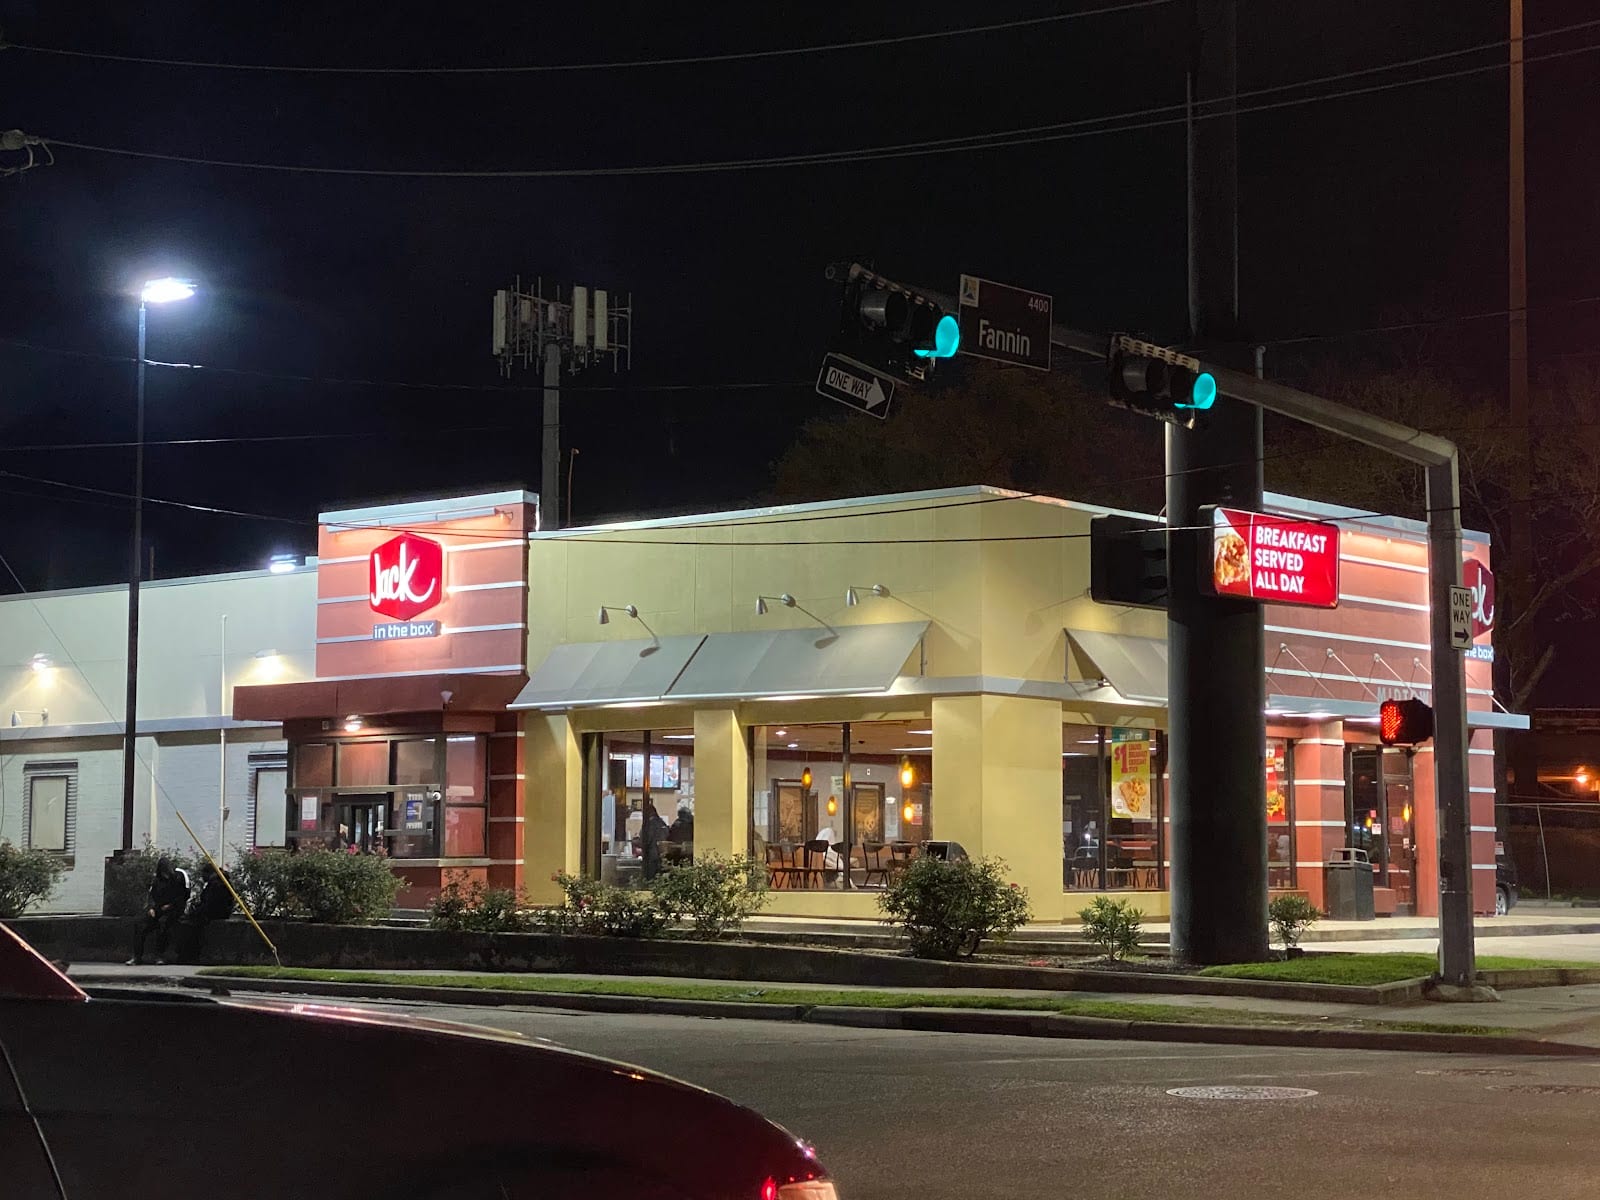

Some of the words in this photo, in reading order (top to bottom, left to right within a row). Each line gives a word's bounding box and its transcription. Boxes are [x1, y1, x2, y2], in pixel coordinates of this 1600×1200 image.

[1028, 297, 1049, 313] 4400
[978, 319, 1031, 357] Fannin
[829, 369, 850, 390] ONE
[851, 378, 872, 398] WAY
[1255, 526, 1327, 554] BREAKFAST
[1255, 548, 1304, 572] SERVED
[370, 543, 435, 607] Jack
[1255, 570, 1279, 591] ALL
[1280, 573, 1305, 594] DAY
[1453, 591, 1470, 608] ONE
[1453, 610, 1470, 625] WAY
[374, 625, 386, 638] in
[387, 624, 408, 638] the
[410, 622, 433, 637] box
[1477, 645, 1494, 661] box
